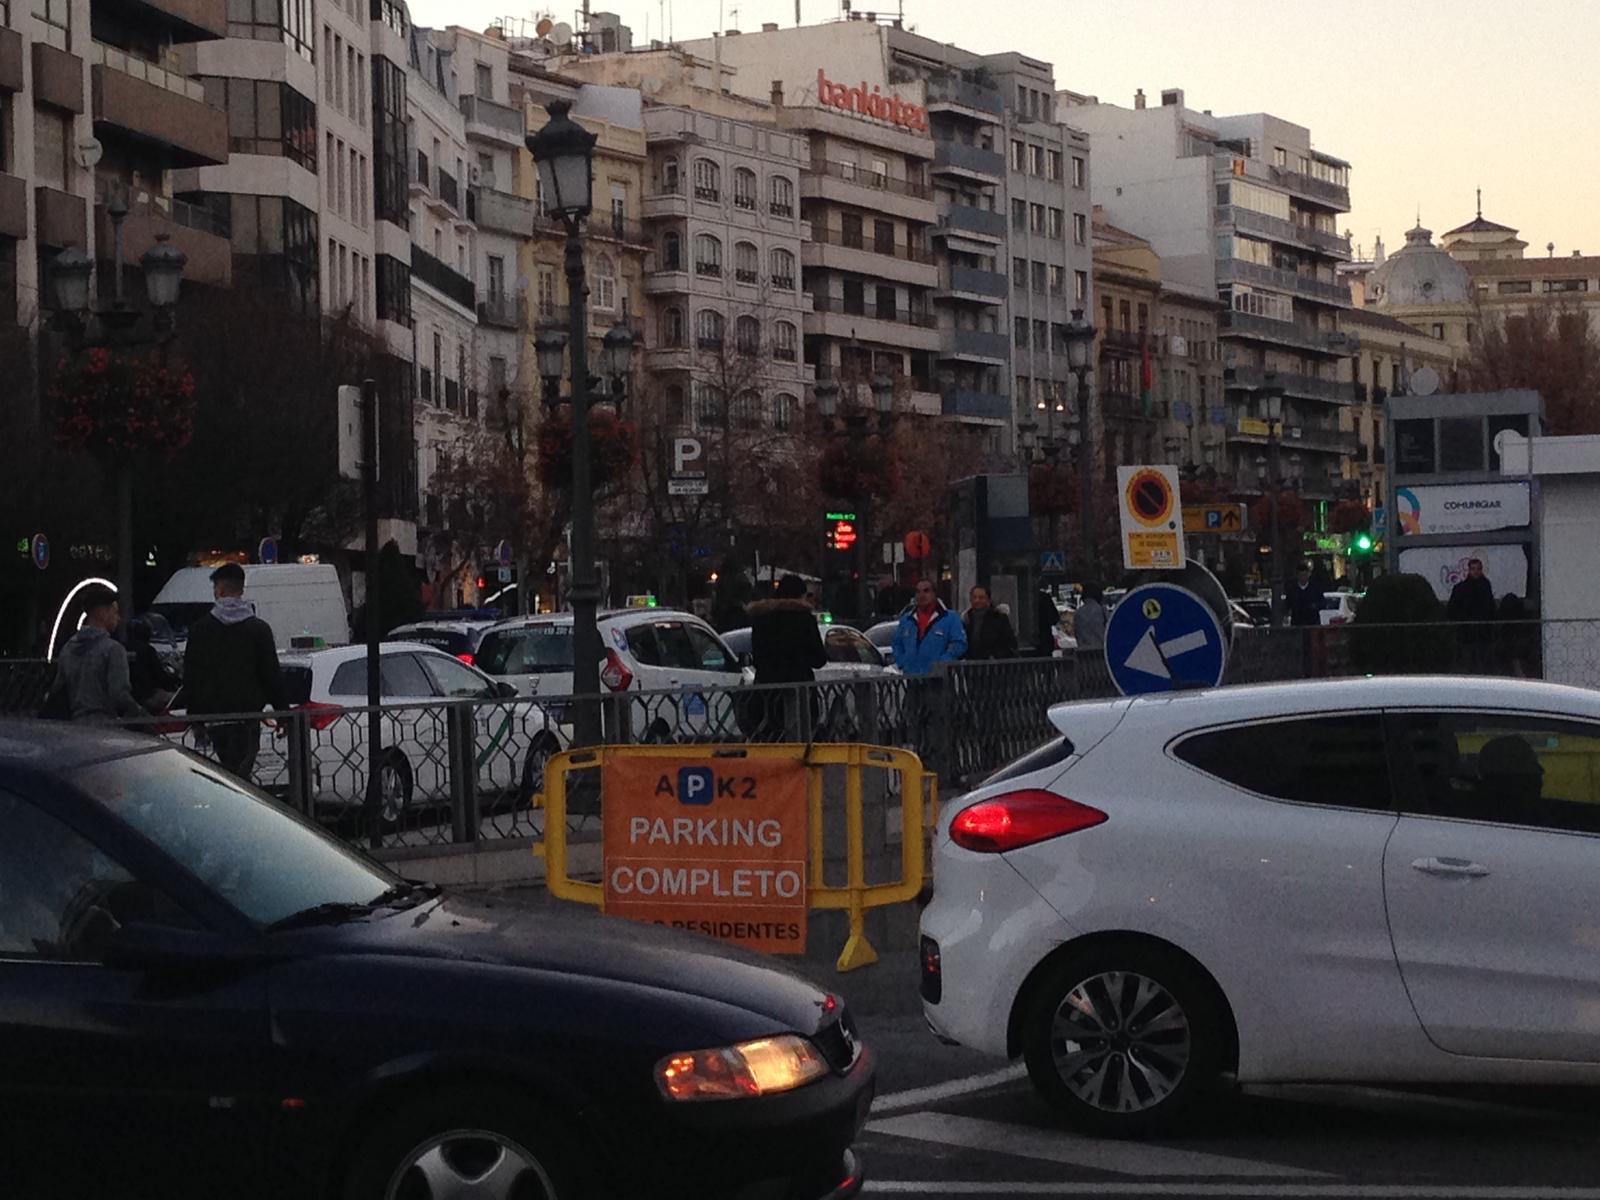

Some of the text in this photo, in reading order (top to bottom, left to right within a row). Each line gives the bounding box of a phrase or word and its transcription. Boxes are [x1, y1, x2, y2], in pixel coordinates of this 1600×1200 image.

[818, 68, 928, 132] bankinter
[674, 438, 702, 472] P
[1207, 512, 1218, 527] P
[629, 817, 782, 848] PARKING
[610, 866, 801, 899] COMPLETO
